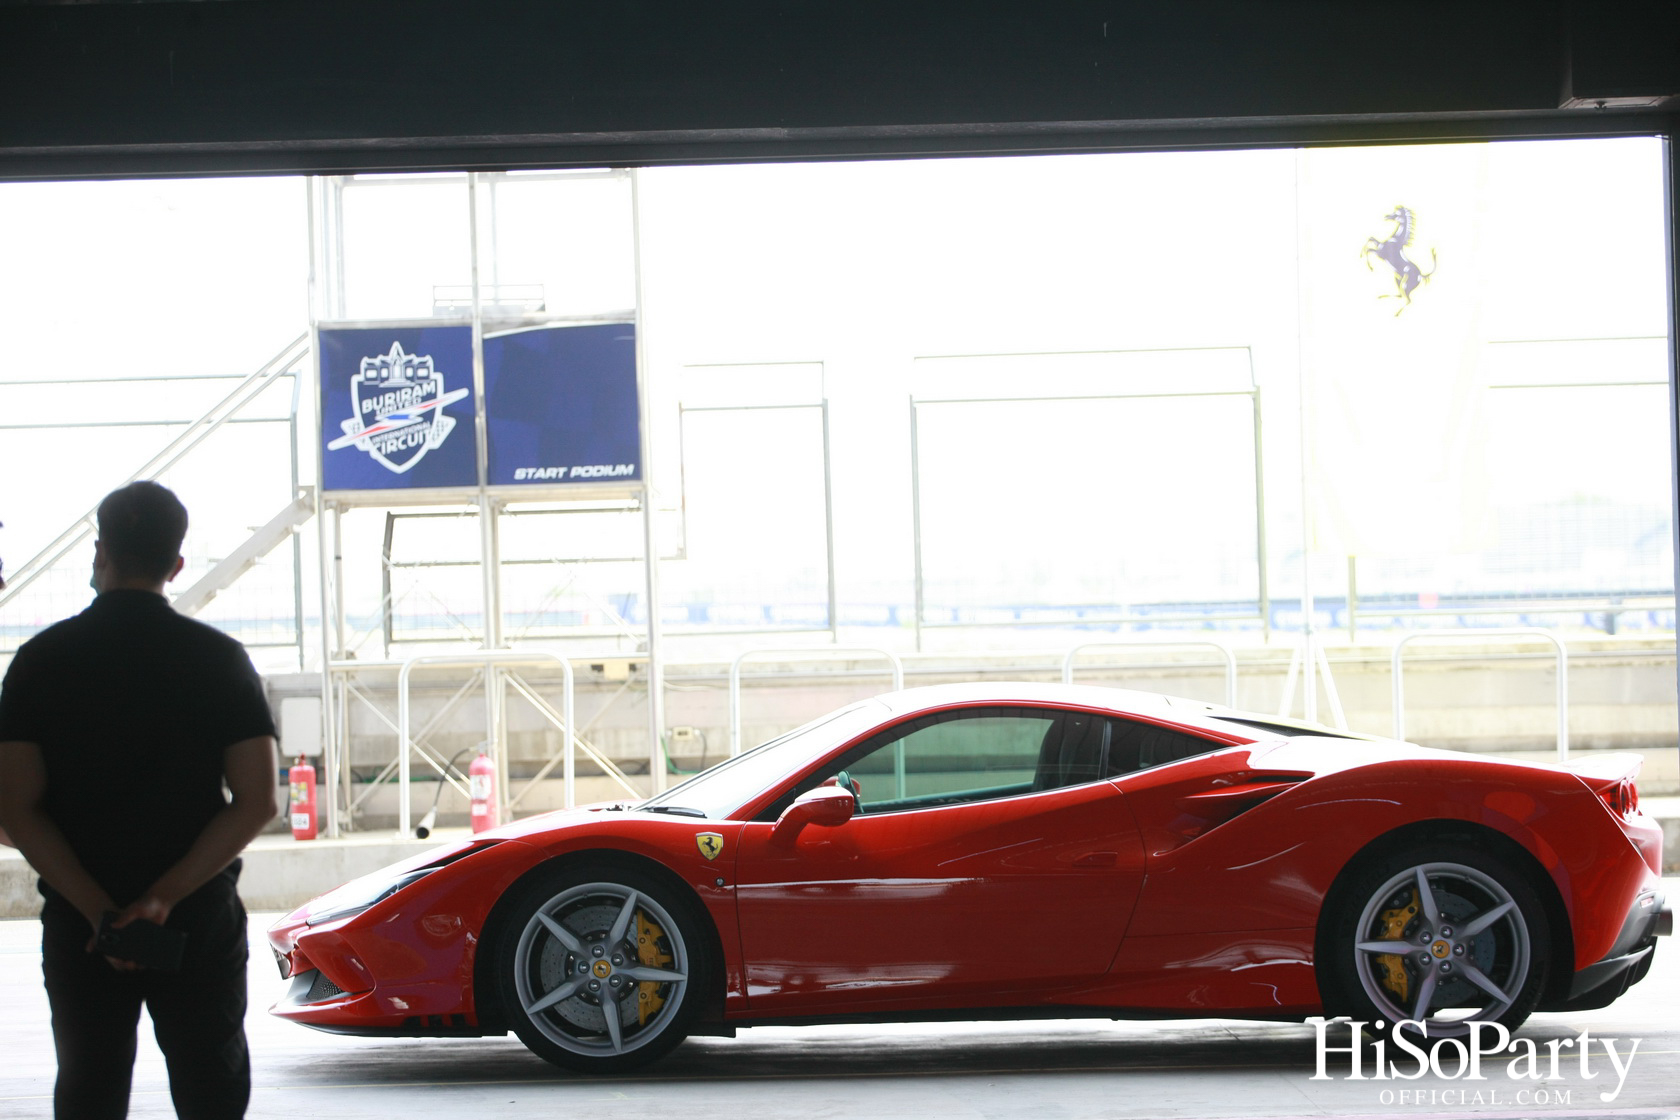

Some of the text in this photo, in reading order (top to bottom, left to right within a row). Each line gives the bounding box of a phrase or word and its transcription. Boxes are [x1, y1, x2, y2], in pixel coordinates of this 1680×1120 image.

[362, 381, 436, 414] BURIRAM
[514, 464, 635, 480] START PODIUM
